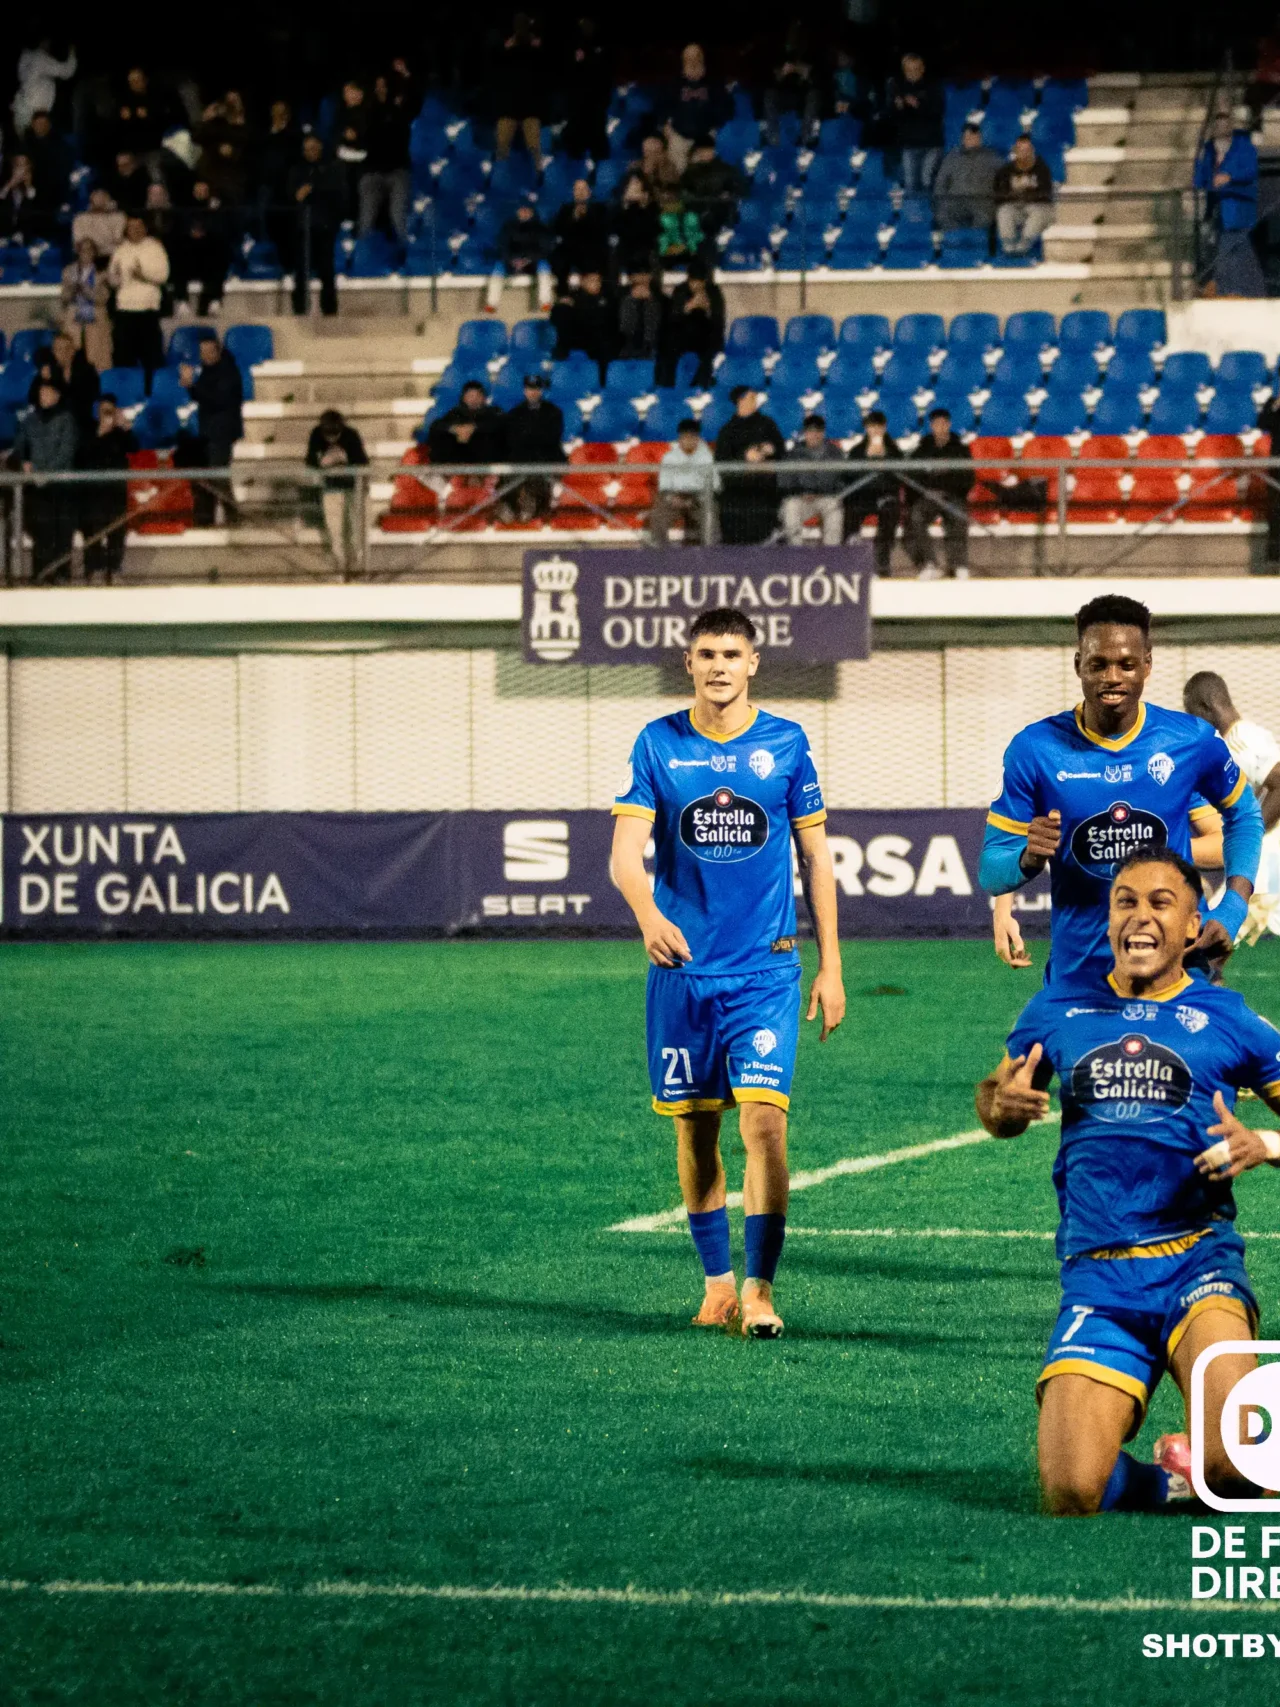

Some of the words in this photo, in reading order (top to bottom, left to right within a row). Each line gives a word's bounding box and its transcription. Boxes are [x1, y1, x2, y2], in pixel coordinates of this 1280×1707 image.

[603, 565, 863, 609] DEPUTACIÓN
[602, 612, 794, 649] OURSE
[692, 807, 755, 826] Estrella
[20, 824, 187, 866] XUNTA
[694, 825, 752, 843] Galicia
[1086, 823, 1154, 843] Estrella
[1089, 840, 1148, 860] Galici
[18, 872, 80, 915] DE
[95, 871, 291, 915] GALICIA
[481, 893, 592, 917] SEAT
[661, 1046, 694, 1086] 21
[1089, 1058, 1174, 1082] Estrella
[740, 1072, 781, 1088] Ontime
[1093, 1078, 1167, 1101] Galicia
[1061, 1304, 1095, 1343] 7
